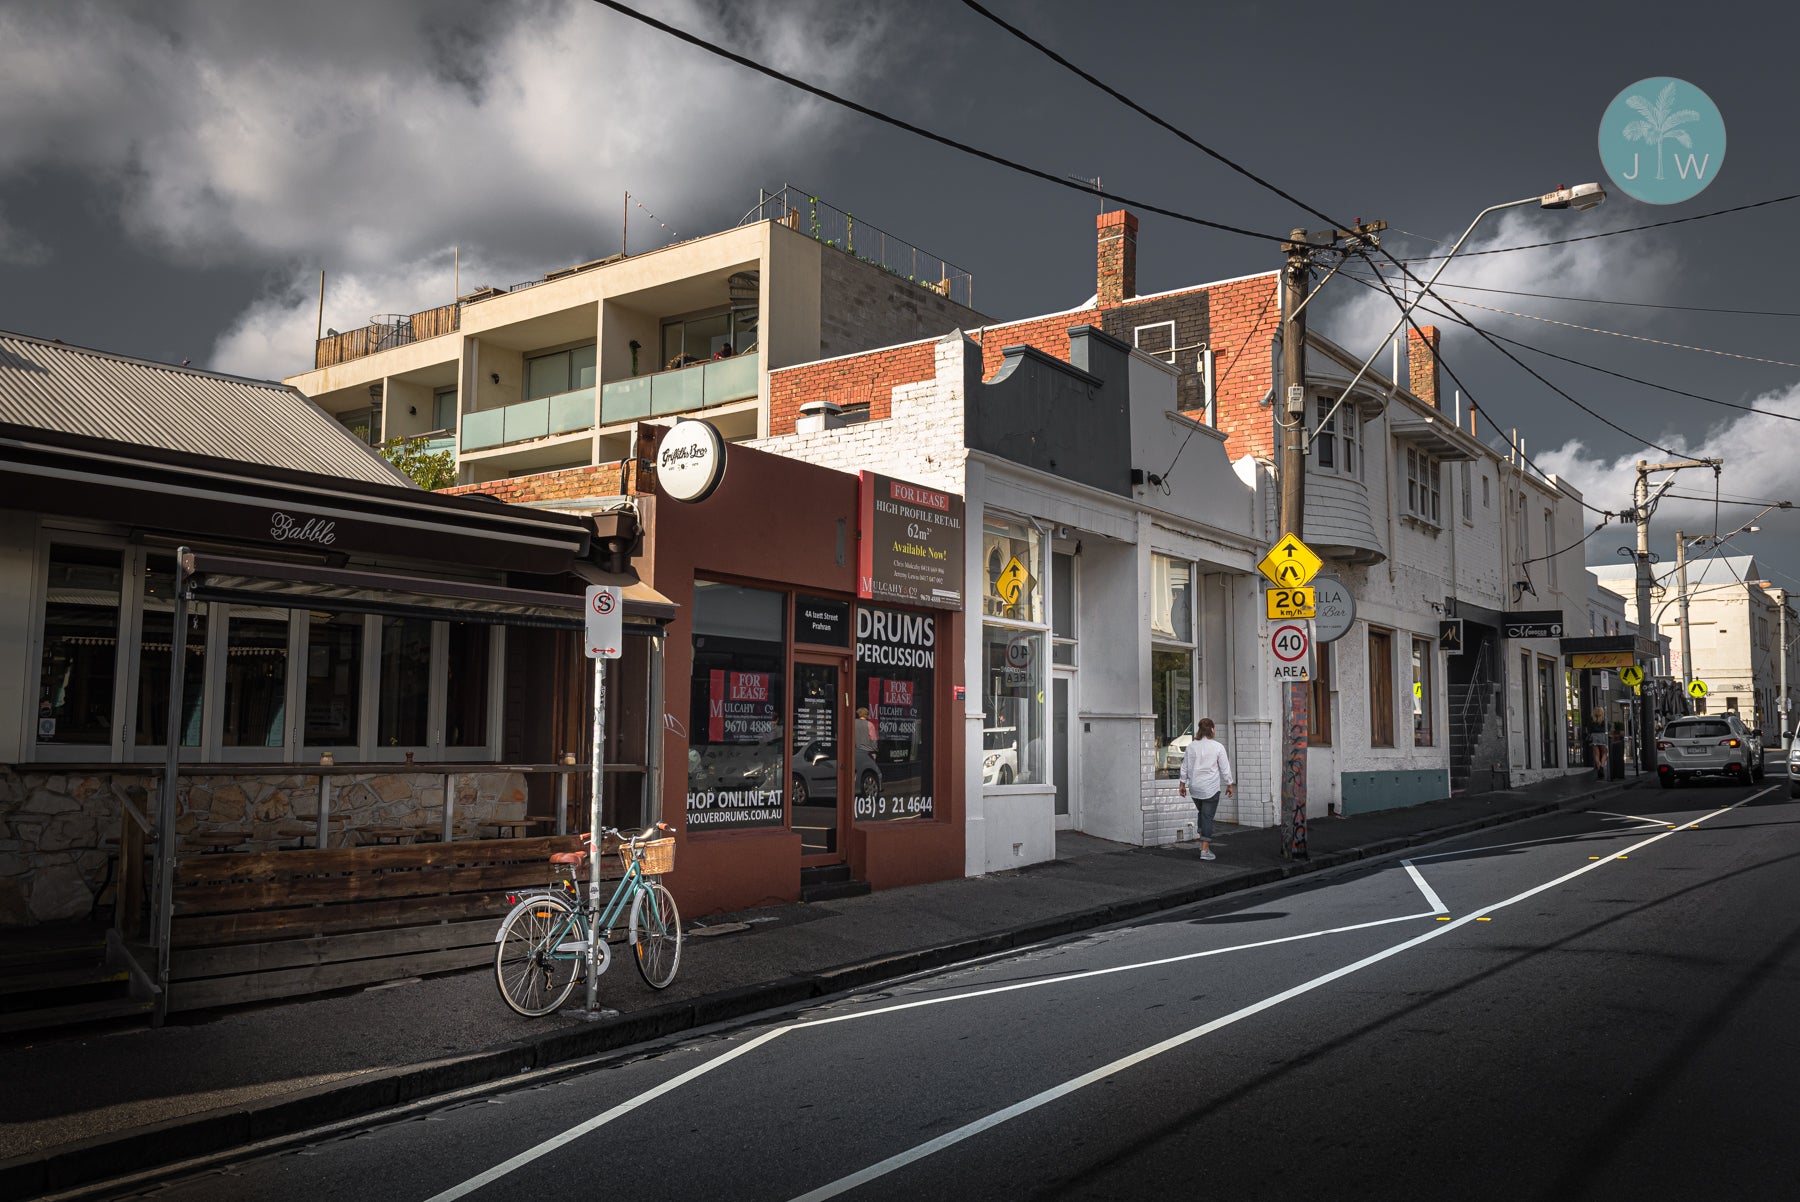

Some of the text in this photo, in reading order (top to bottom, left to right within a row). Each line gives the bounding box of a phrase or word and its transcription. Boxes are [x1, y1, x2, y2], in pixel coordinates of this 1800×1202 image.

[661, 443, 708, 468] Griffiths Bros
[894, 484, 945, 509] FOR LEASE
[876, 499, 961, 529] HIGH PROFILE RETAIL
[270, 511, 336, 545] Babble
[892, 540, 947, 561] Available Now!
[861, 576, 903, 594] MULCAHY
[1275, 591, 1306, 608] 20
[1315, 591, 1342, 603] LLA
[823, 612, 839, 622] Street
[1280, 609, 1303, 617] km/h
[1321, 605, 1346, 618] Bar
[812, 621, 832, 631] Prahran
[856, 607, 935, 647] DRUMS
[1277, 634, 1302, 651] 40
[856, 642, 934, 669] PERCUSSION
[739, 673, 761, 687] FOR
[1274, 665, 1308, 678] AREA
[732, 686, 766, 700] LEASE
[890, 681, 907, 693] FOR
[885, 692, 912, 705] LEASE
[710, 699, 755, 718] MULCAHY
[869, 703, 904, 720] MULCAHY
[724, 720, 772, 733] 9670 4888
[879, 721, 916, 734] 9670 4888
[718, 790, 765, 808] ONLINE
[767, 789, 783, 806] AT
[854, 796, 876, 818] (03)
[907, 796, 933, 813] 4644
